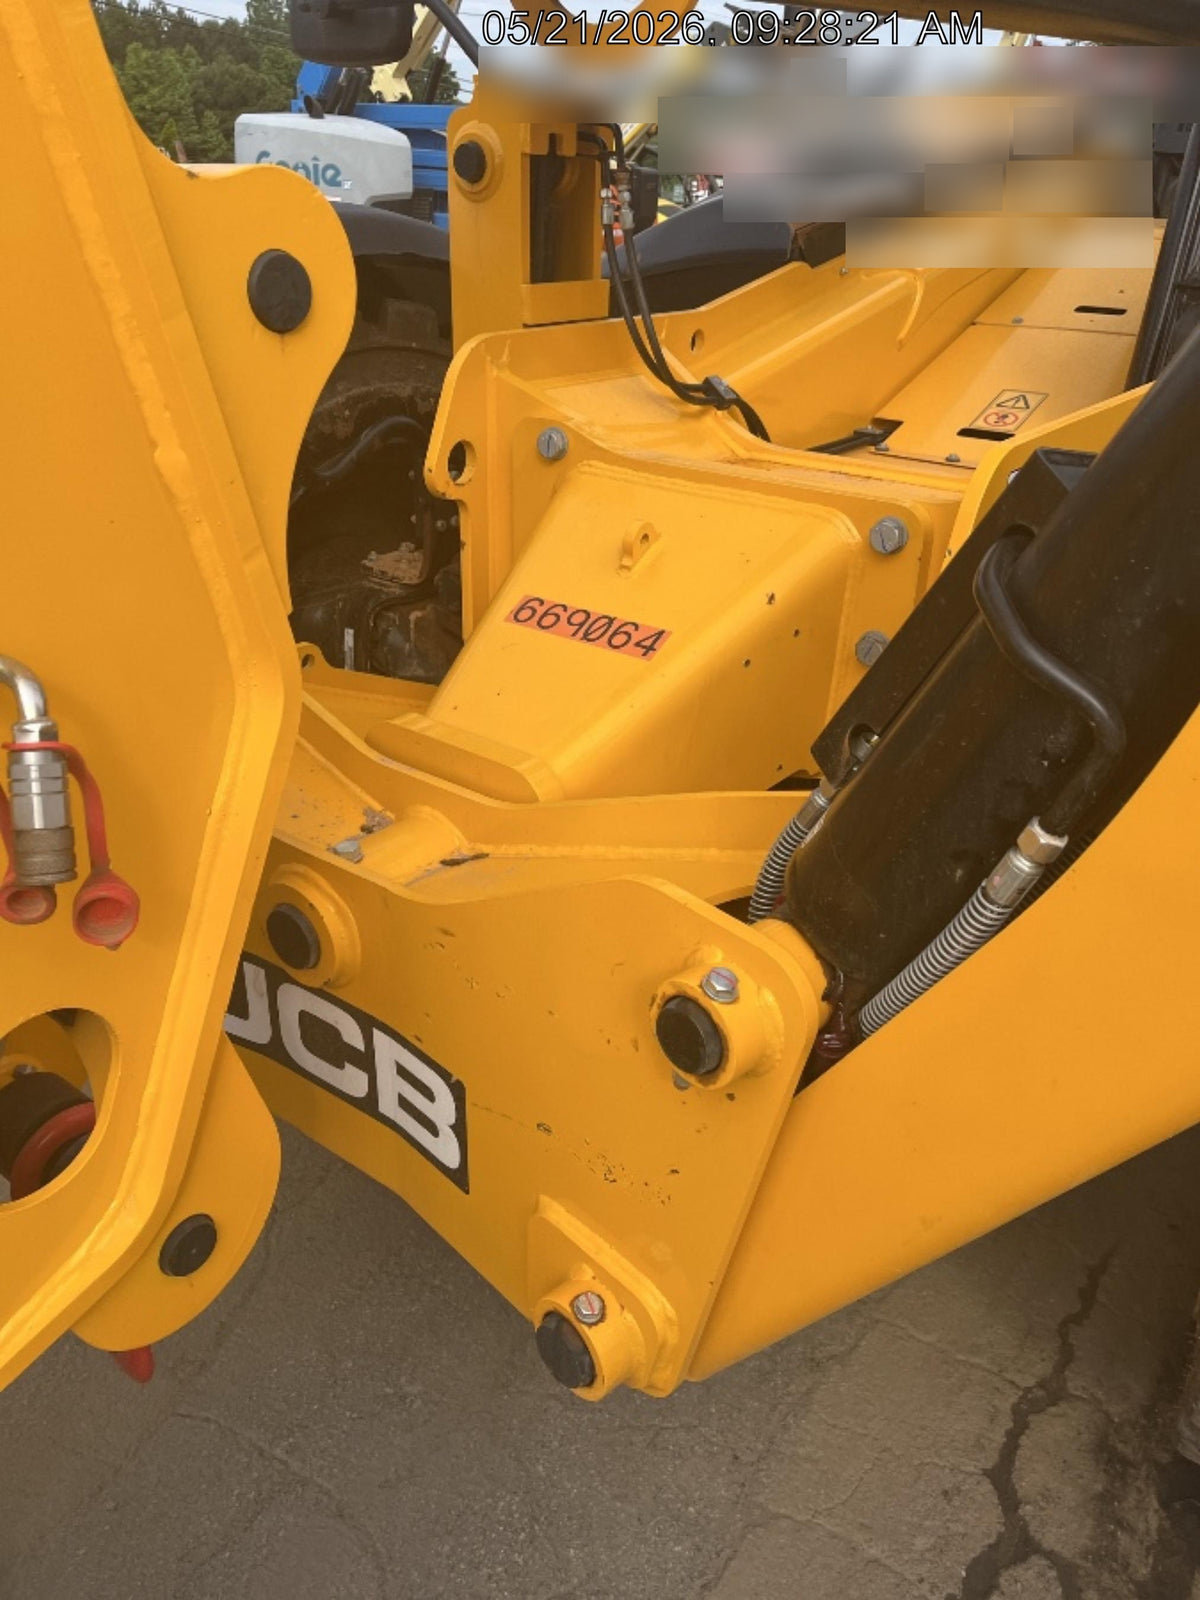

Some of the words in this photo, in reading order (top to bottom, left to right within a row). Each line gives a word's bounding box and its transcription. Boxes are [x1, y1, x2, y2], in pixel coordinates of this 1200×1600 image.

[256, 150, 342, 187] nie
[513, 597, 666, 657] 669064
[224, 961, 461, 1169] JCB
